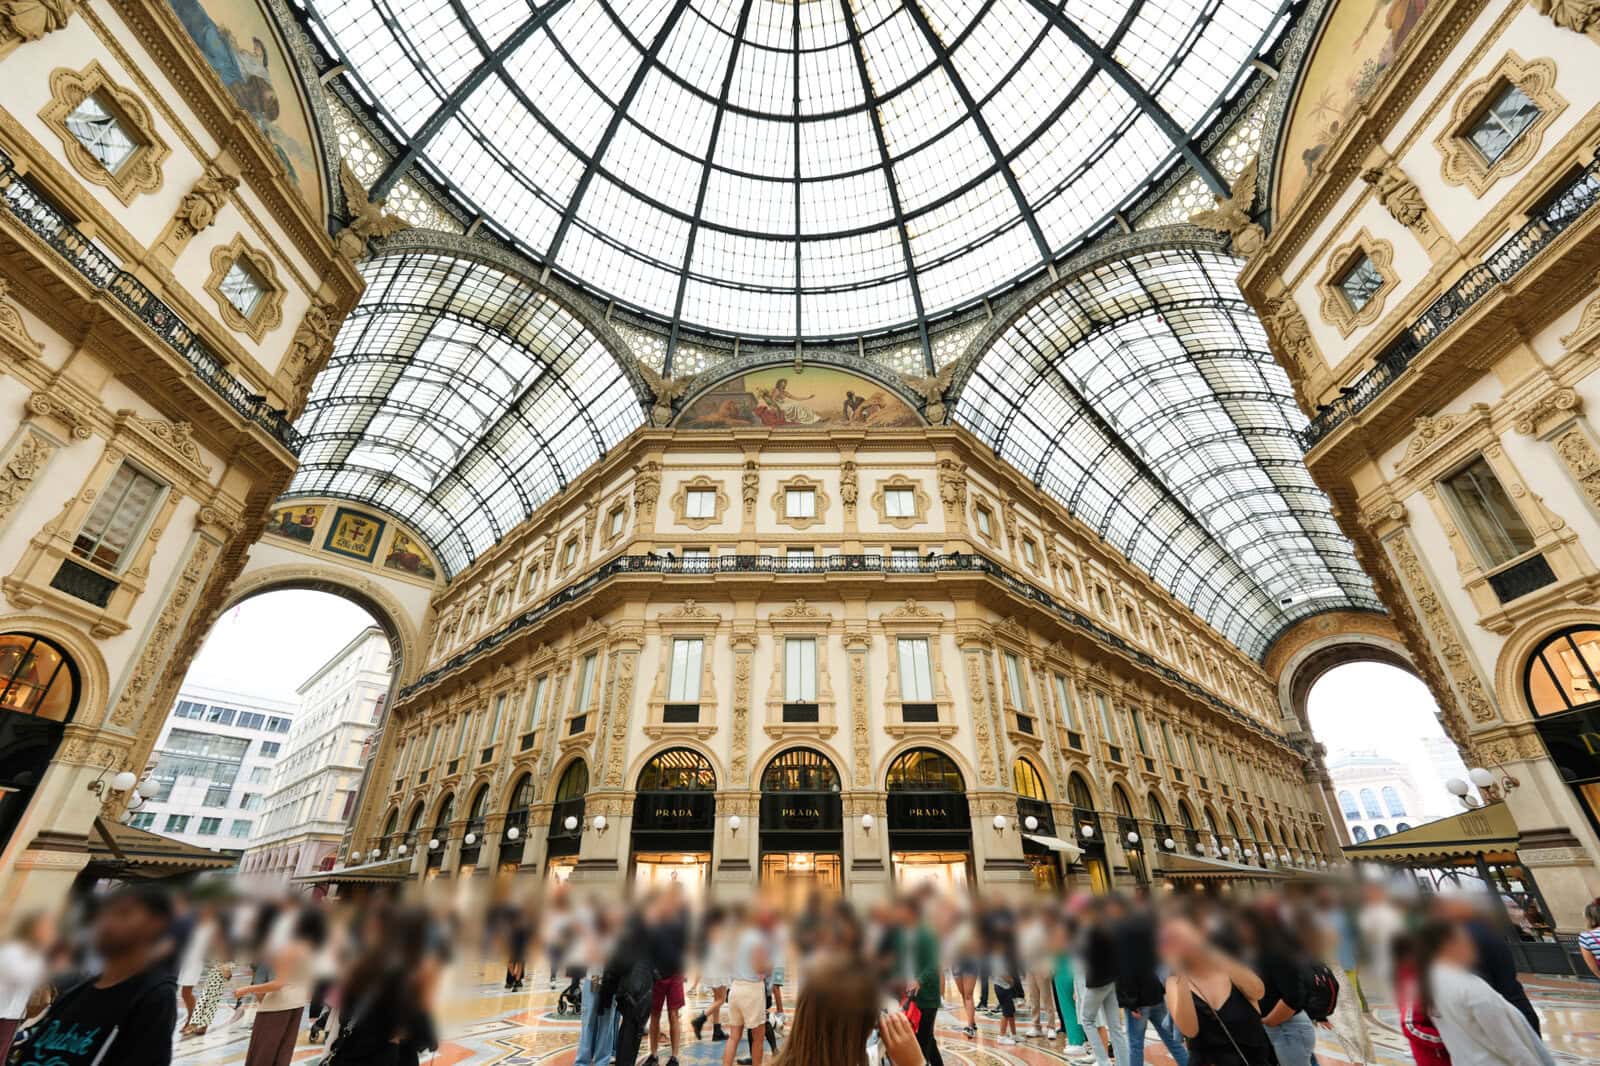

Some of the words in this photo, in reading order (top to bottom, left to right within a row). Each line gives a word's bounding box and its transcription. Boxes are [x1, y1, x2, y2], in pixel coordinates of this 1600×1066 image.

[655, 808, 693, 817] PRADA
[782, 808, 820, 817] PRADA
[909, 808, 947, 817] PRADA
